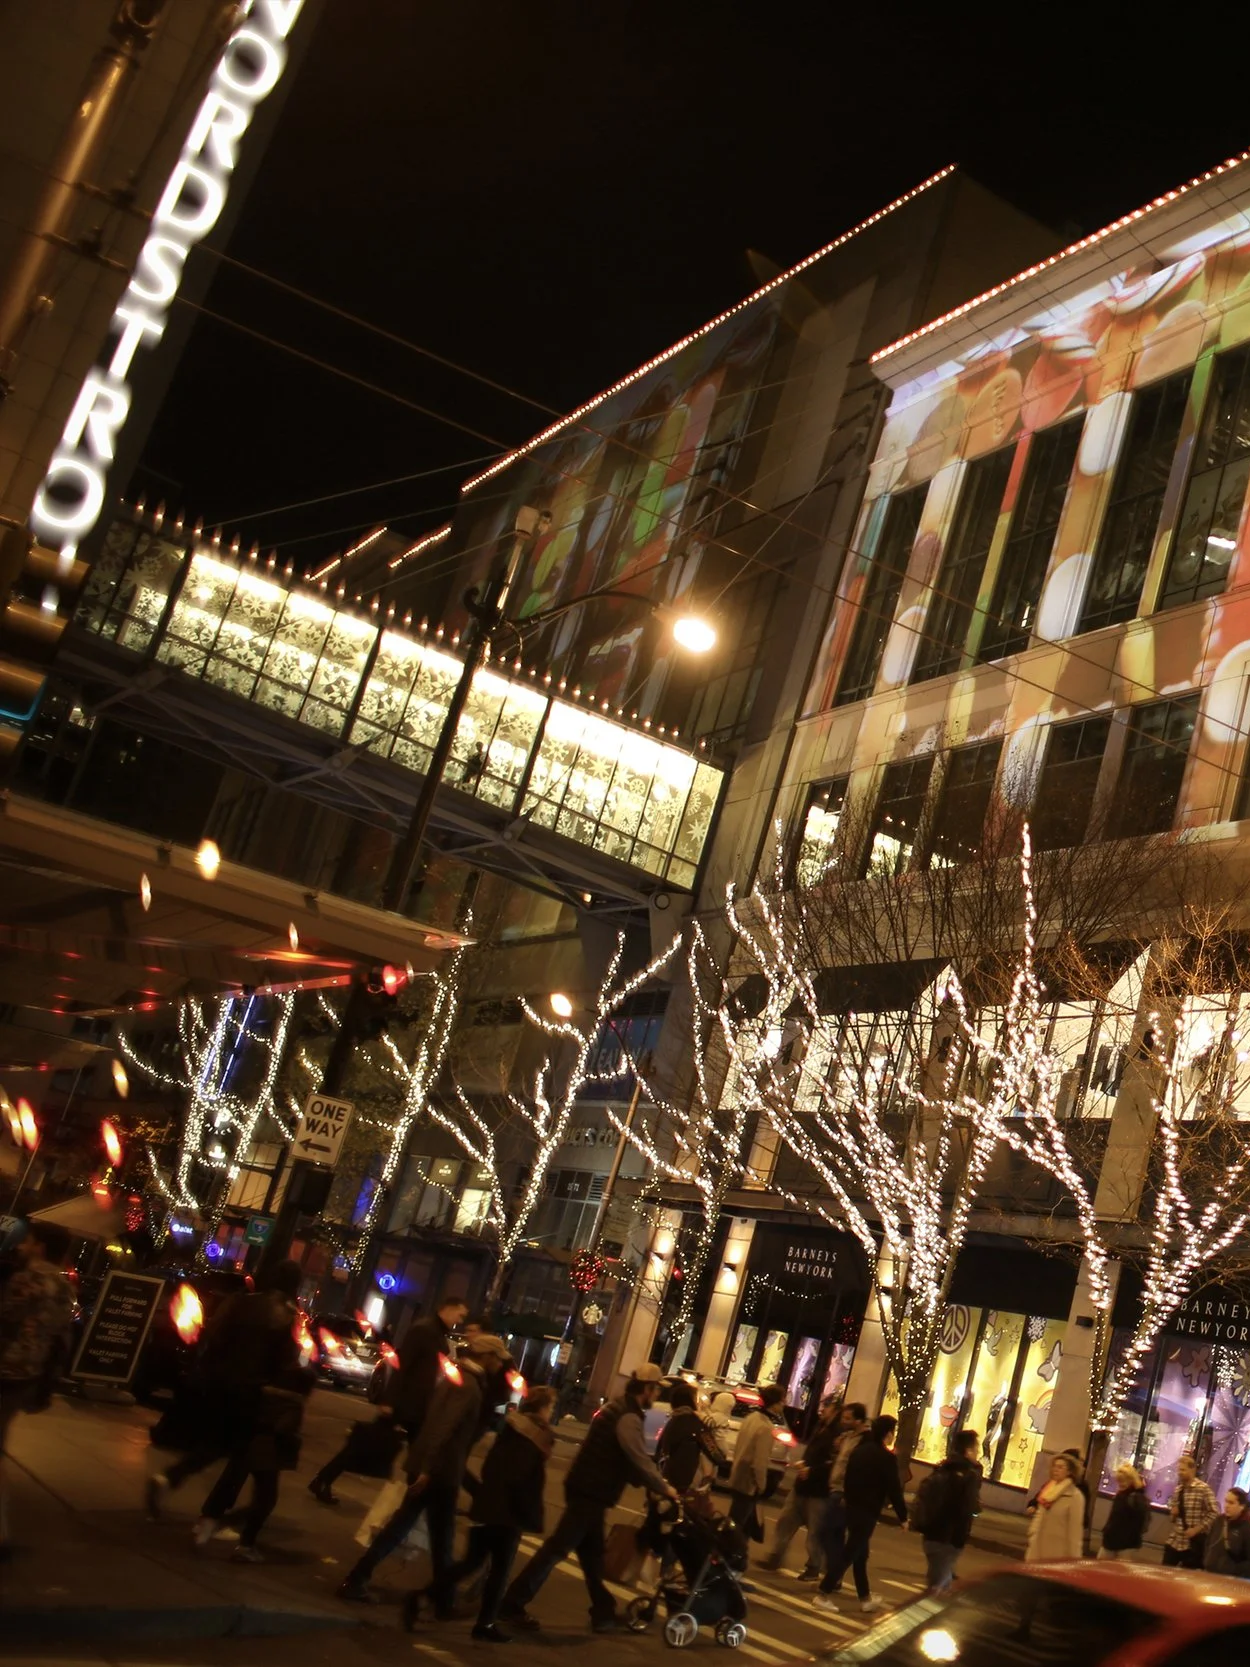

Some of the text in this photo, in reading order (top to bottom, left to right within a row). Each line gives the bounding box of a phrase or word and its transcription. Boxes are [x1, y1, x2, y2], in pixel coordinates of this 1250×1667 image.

[33, 0, 302, 566] ORDSTRO
[310, 1100, 348, 1122] ONE
[305, 1117, 343, 1139] WAY
[787, 1246, 838, 1263] BARNEYS
